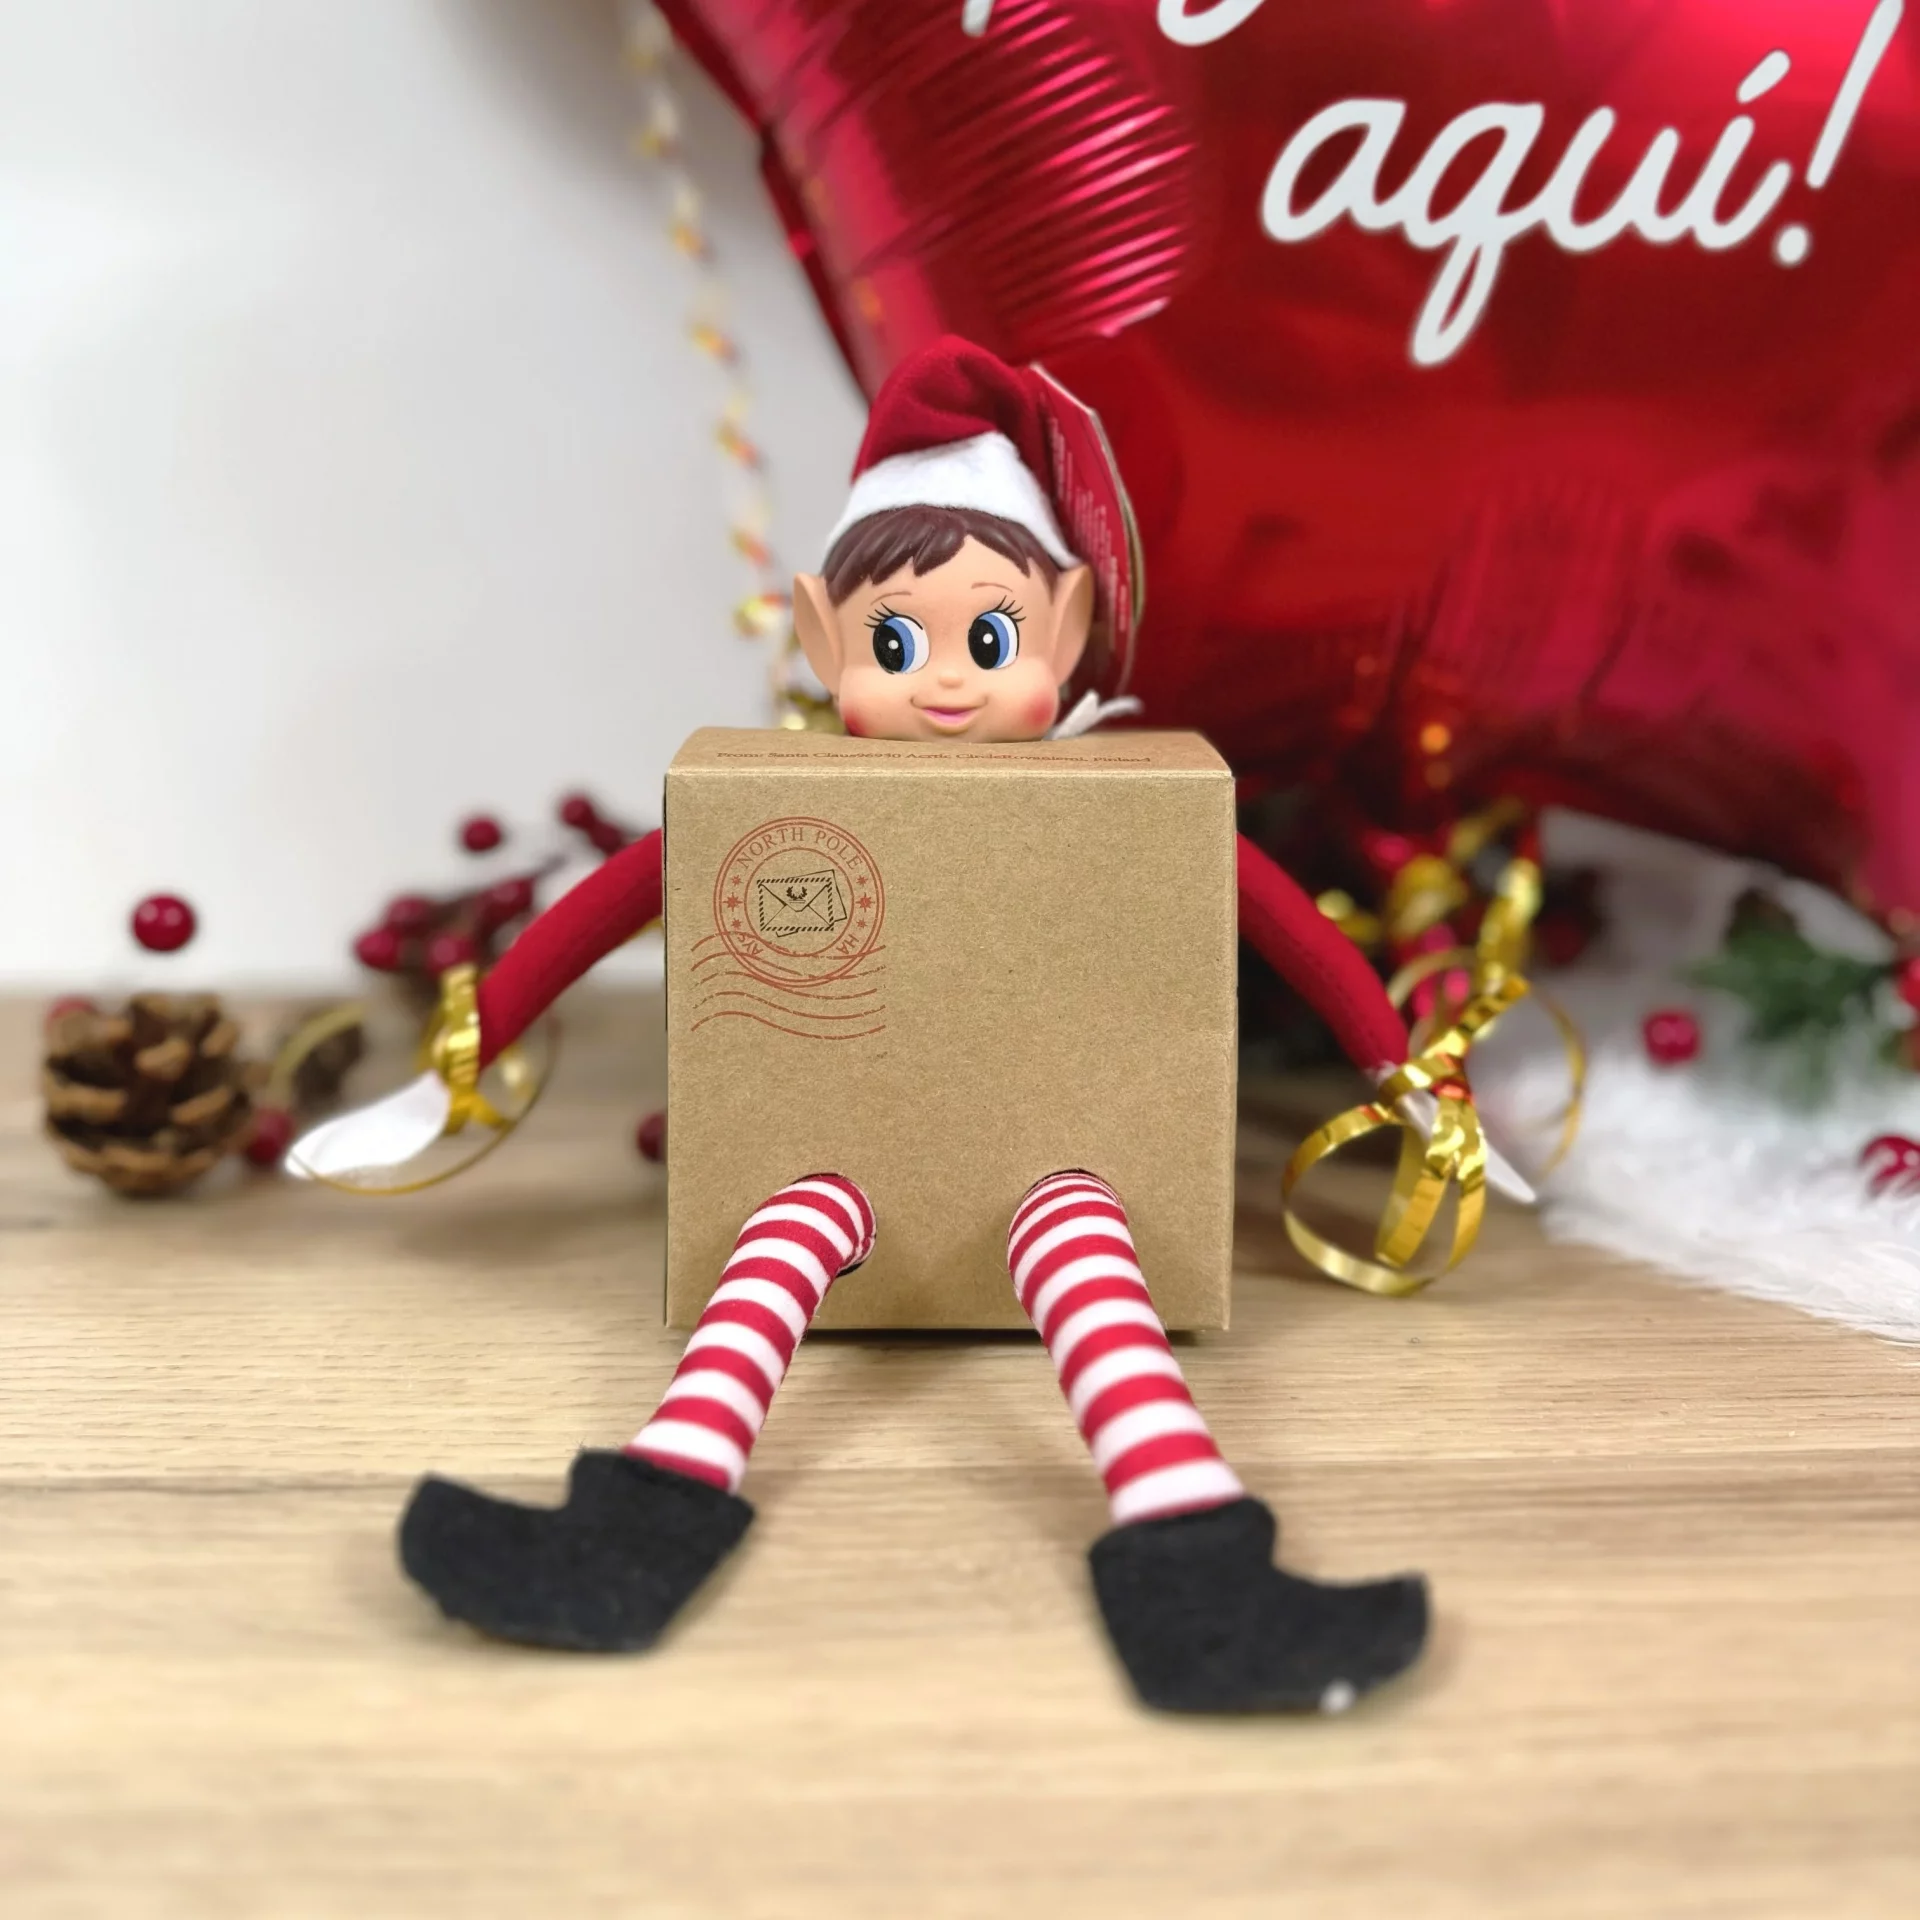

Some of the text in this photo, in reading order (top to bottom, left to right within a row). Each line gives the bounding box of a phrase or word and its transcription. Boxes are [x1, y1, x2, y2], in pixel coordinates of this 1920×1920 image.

[1262, 0, 1906, 366] aquí!
[736, 826, 863, 871] NORTH POLE
